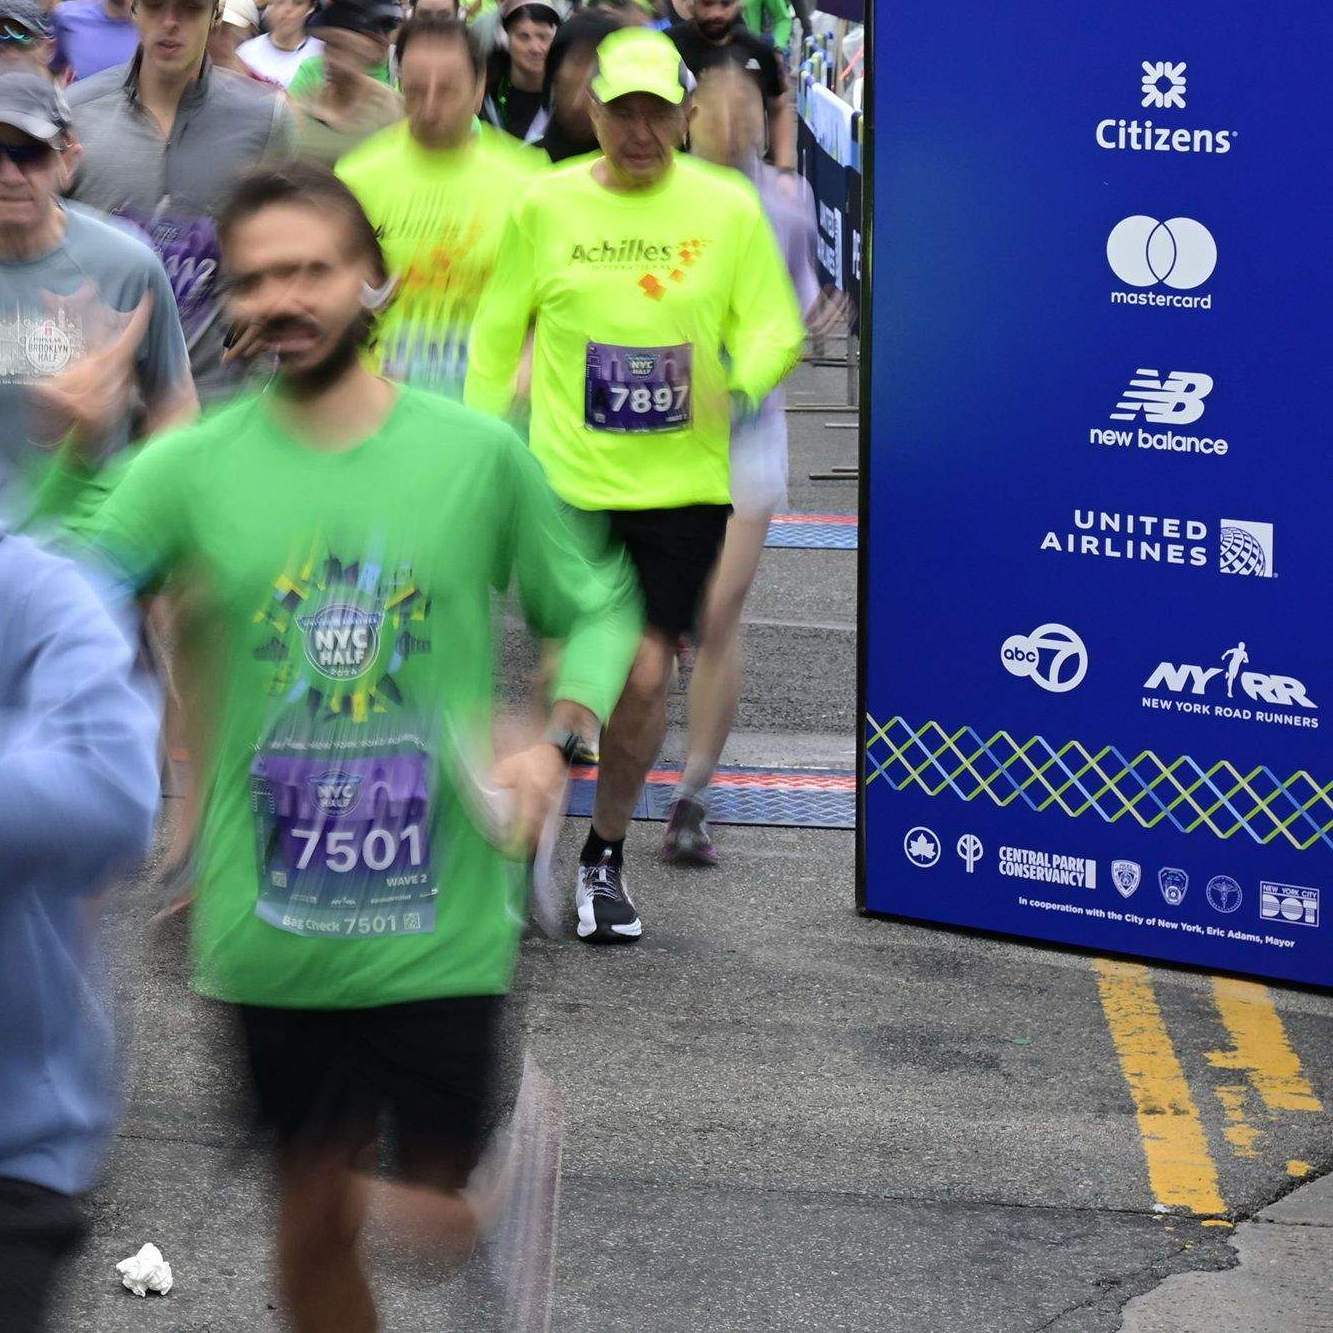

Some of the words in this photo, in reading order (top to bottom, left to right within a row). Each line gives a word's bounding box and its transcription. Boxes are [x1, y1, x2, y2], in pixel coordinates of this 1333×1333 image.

[1096, 119, 1230, 153] Citizens
[569, 238, 672, 265] Achilles
[1111, 290, 1212, 309] mastercard
[610, 385, 689, 414] 7897
[1091, 429, 1133, 446] new
[1138, 429, 1228, 455] balance
[1074, 509, 1207, 540] UNITED
[1041, 531, 1207, 566] AIRLINES
[315, 627, 368, 651] NYC
[1004, 647, 1036, 663] abc
[1142, 697, 1173, 710] NEW
[1176, 701, 1210, 716] YORK
[1214, 705, 1252, 720] ROAD
[1255, 710, 1319, 729] RUNNERS
[291, 824, 422, 873] 7501
[999, 845, 1051, 867] CENTRAL
[1052, 854, 1085, 873] PARK
[386, 875, 419, 887] WAVE
[420, 873, 429, 884] 2
[998, 861, 1085, 888] CONSERVANCY
[1262, 884, 1279, 894] NEW
[1281, 887, 1300, 897] YORK
[1301, 890, 1317, 899] CITY
[1019, 896, 1028, 906] In
[1029, 899, 1084, 915] cooperation
[1085, 907, 1106, 919] with
[1107, 911, 1123, 921] the
[1124, 913, 1144, 926] City
[1146, 917, 1156, 926] of
[1157, 919, 1178, 930] New
[1181, 923, 1205, 935] York,
[1206, 927, 1225, 938] Eric
[1227, 930, 1263, 944] Adams,
[1265, 935, 1295, 948] Mayor
[1262, 894, 1317, 924] DOT
[283, 914, 304, 931] Bag
[304, 917, 340, 932] Check
[344, 914, 396, 936] 7501
